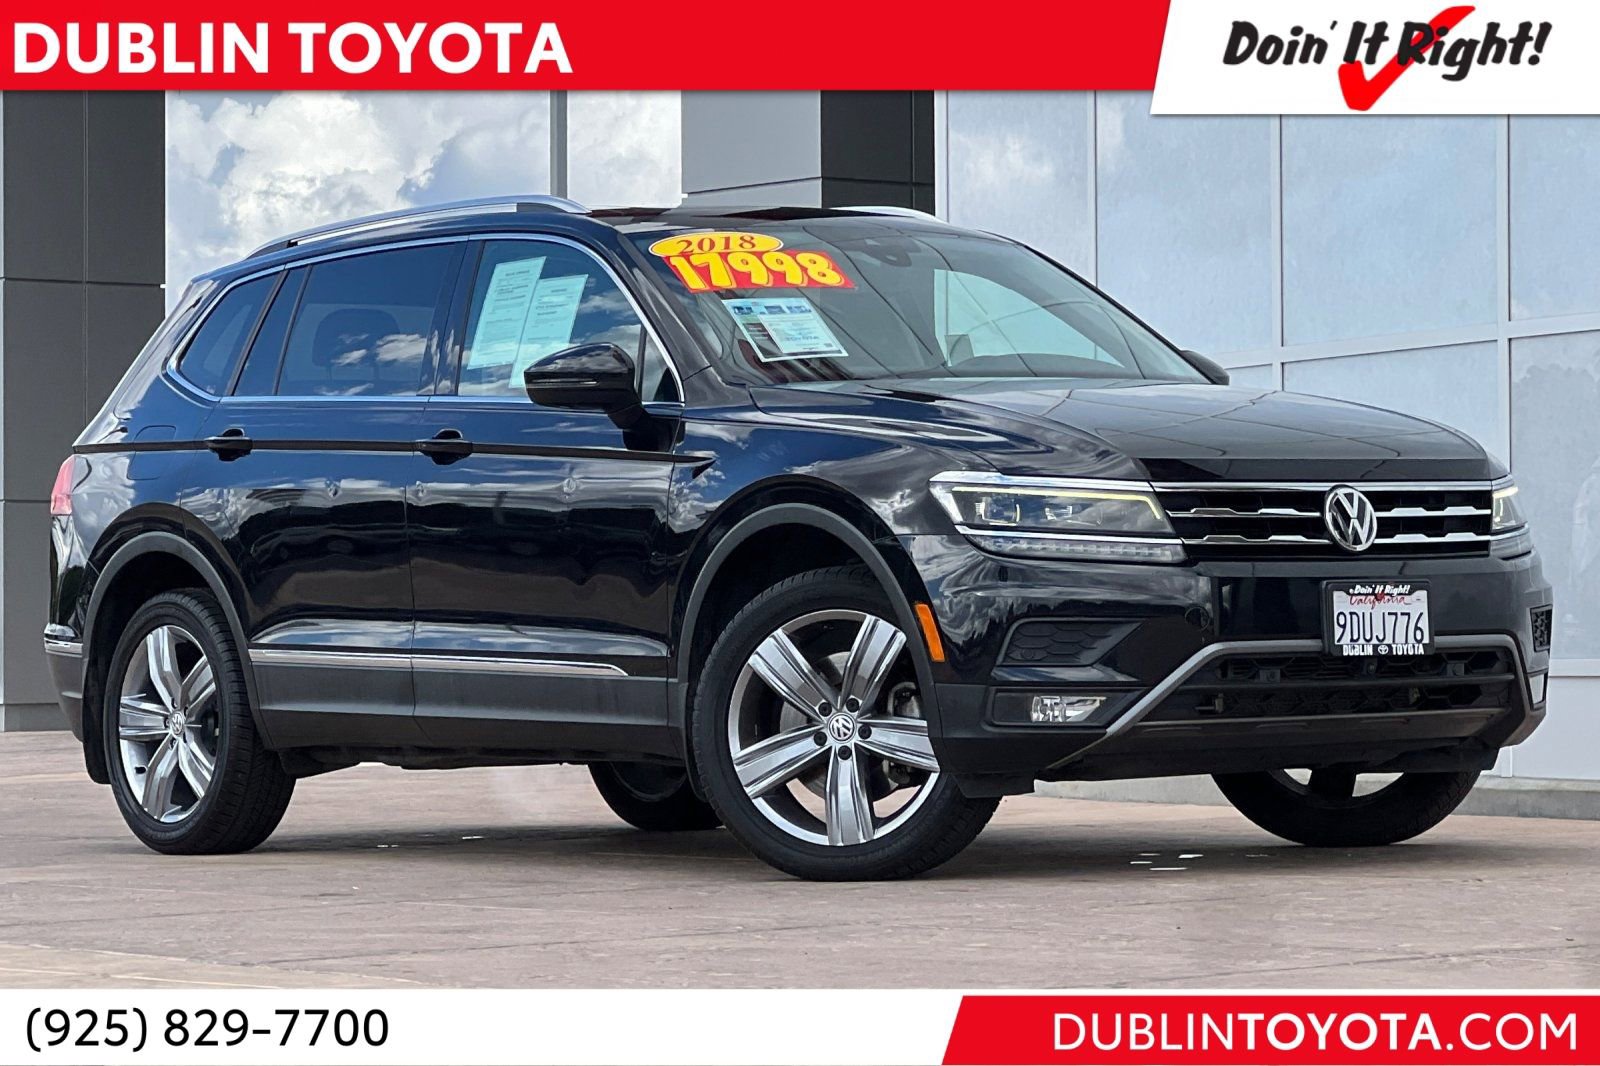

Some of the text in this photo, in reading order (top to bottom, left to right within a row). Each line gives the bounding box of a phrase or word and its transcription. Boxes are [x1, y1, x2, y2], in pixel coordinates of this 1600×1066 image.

[677, 235, 756, 253] 2018
[669, 251, 845, 291] 17998
[1336, 611, 1425, 644] 9DUJ776
[1342, 643, 1425, 656] DUBLIN TOYOTA
